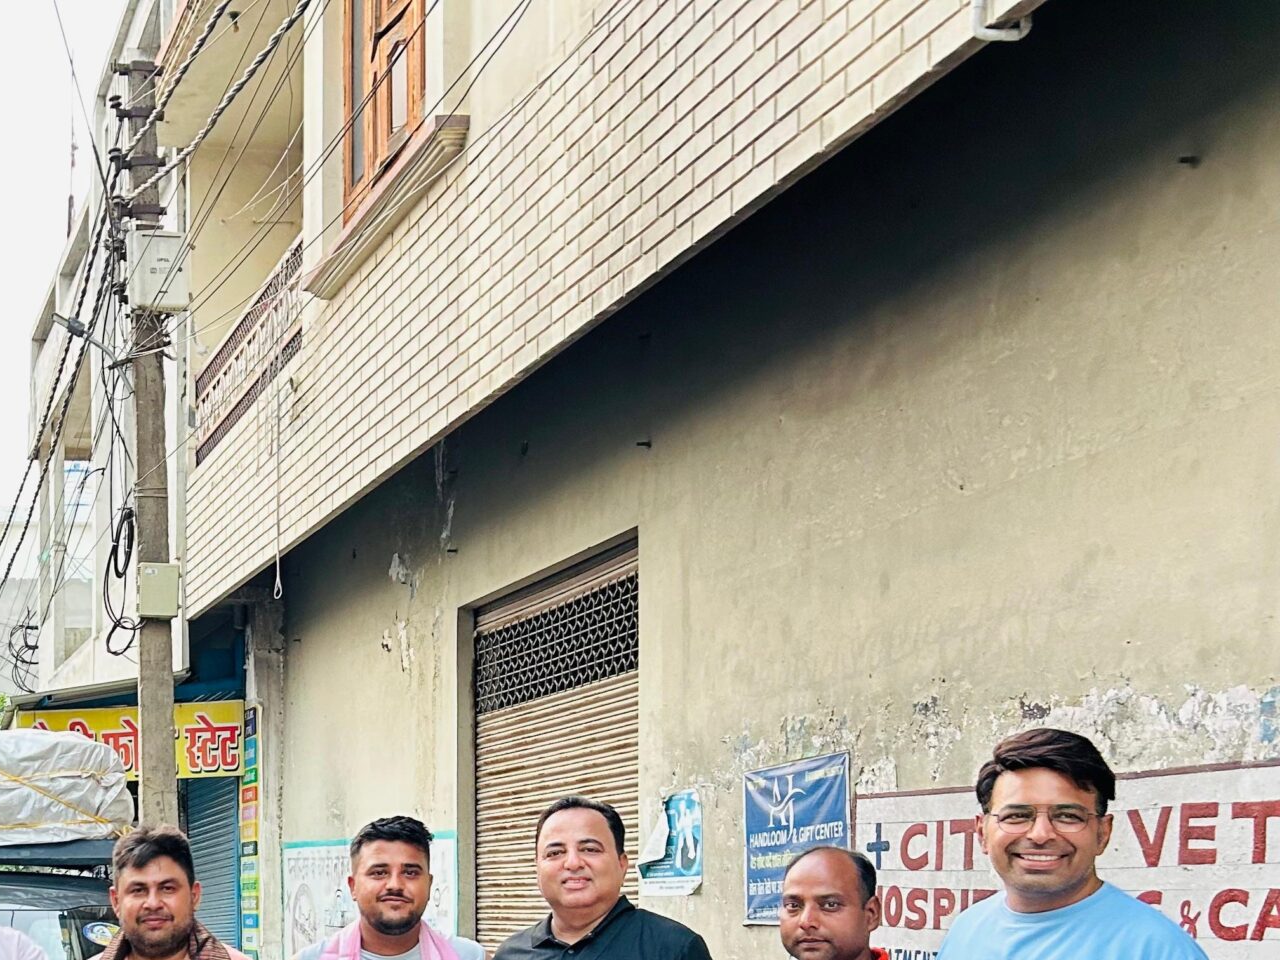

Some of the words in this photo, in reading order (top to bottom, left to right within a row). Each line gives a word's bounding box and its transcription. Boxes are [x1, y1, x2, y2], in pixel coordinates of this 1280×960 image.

[185, 715, 239, 774] स्टेट
[750, 830, 787, 848] HANDLOOM
[792, 831, 798, 844] &
[799, 826, 815, 843] GIFT
[815, 821, 844, 841] CENTER
